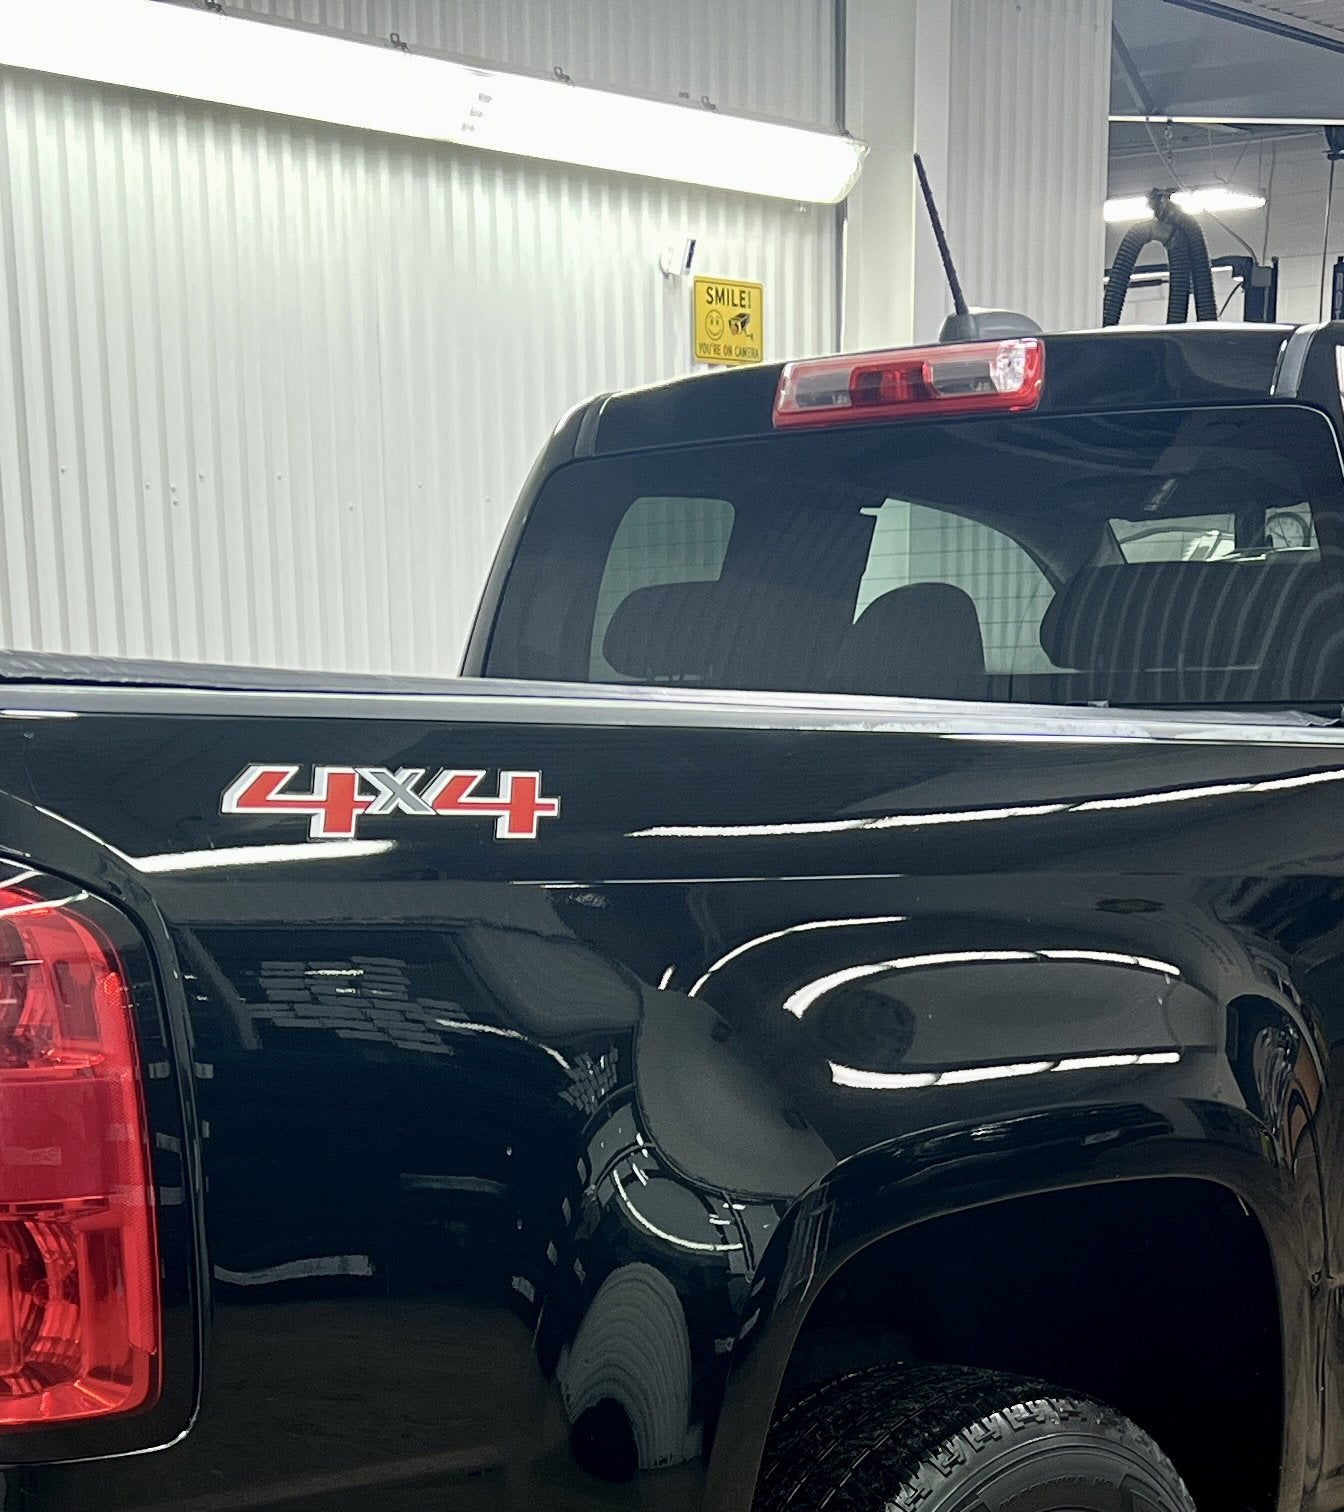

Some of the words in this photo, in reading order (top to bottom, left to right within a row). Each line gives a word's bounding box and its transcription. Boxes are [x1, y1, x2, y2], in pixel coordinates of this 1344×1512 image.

[706, 286, 752, 309] SMILE!
[699, 343, 721, 356] YOU'RE
[723, 344, 733, 357] ON
[735, 346, 760, 359] CAMERA
